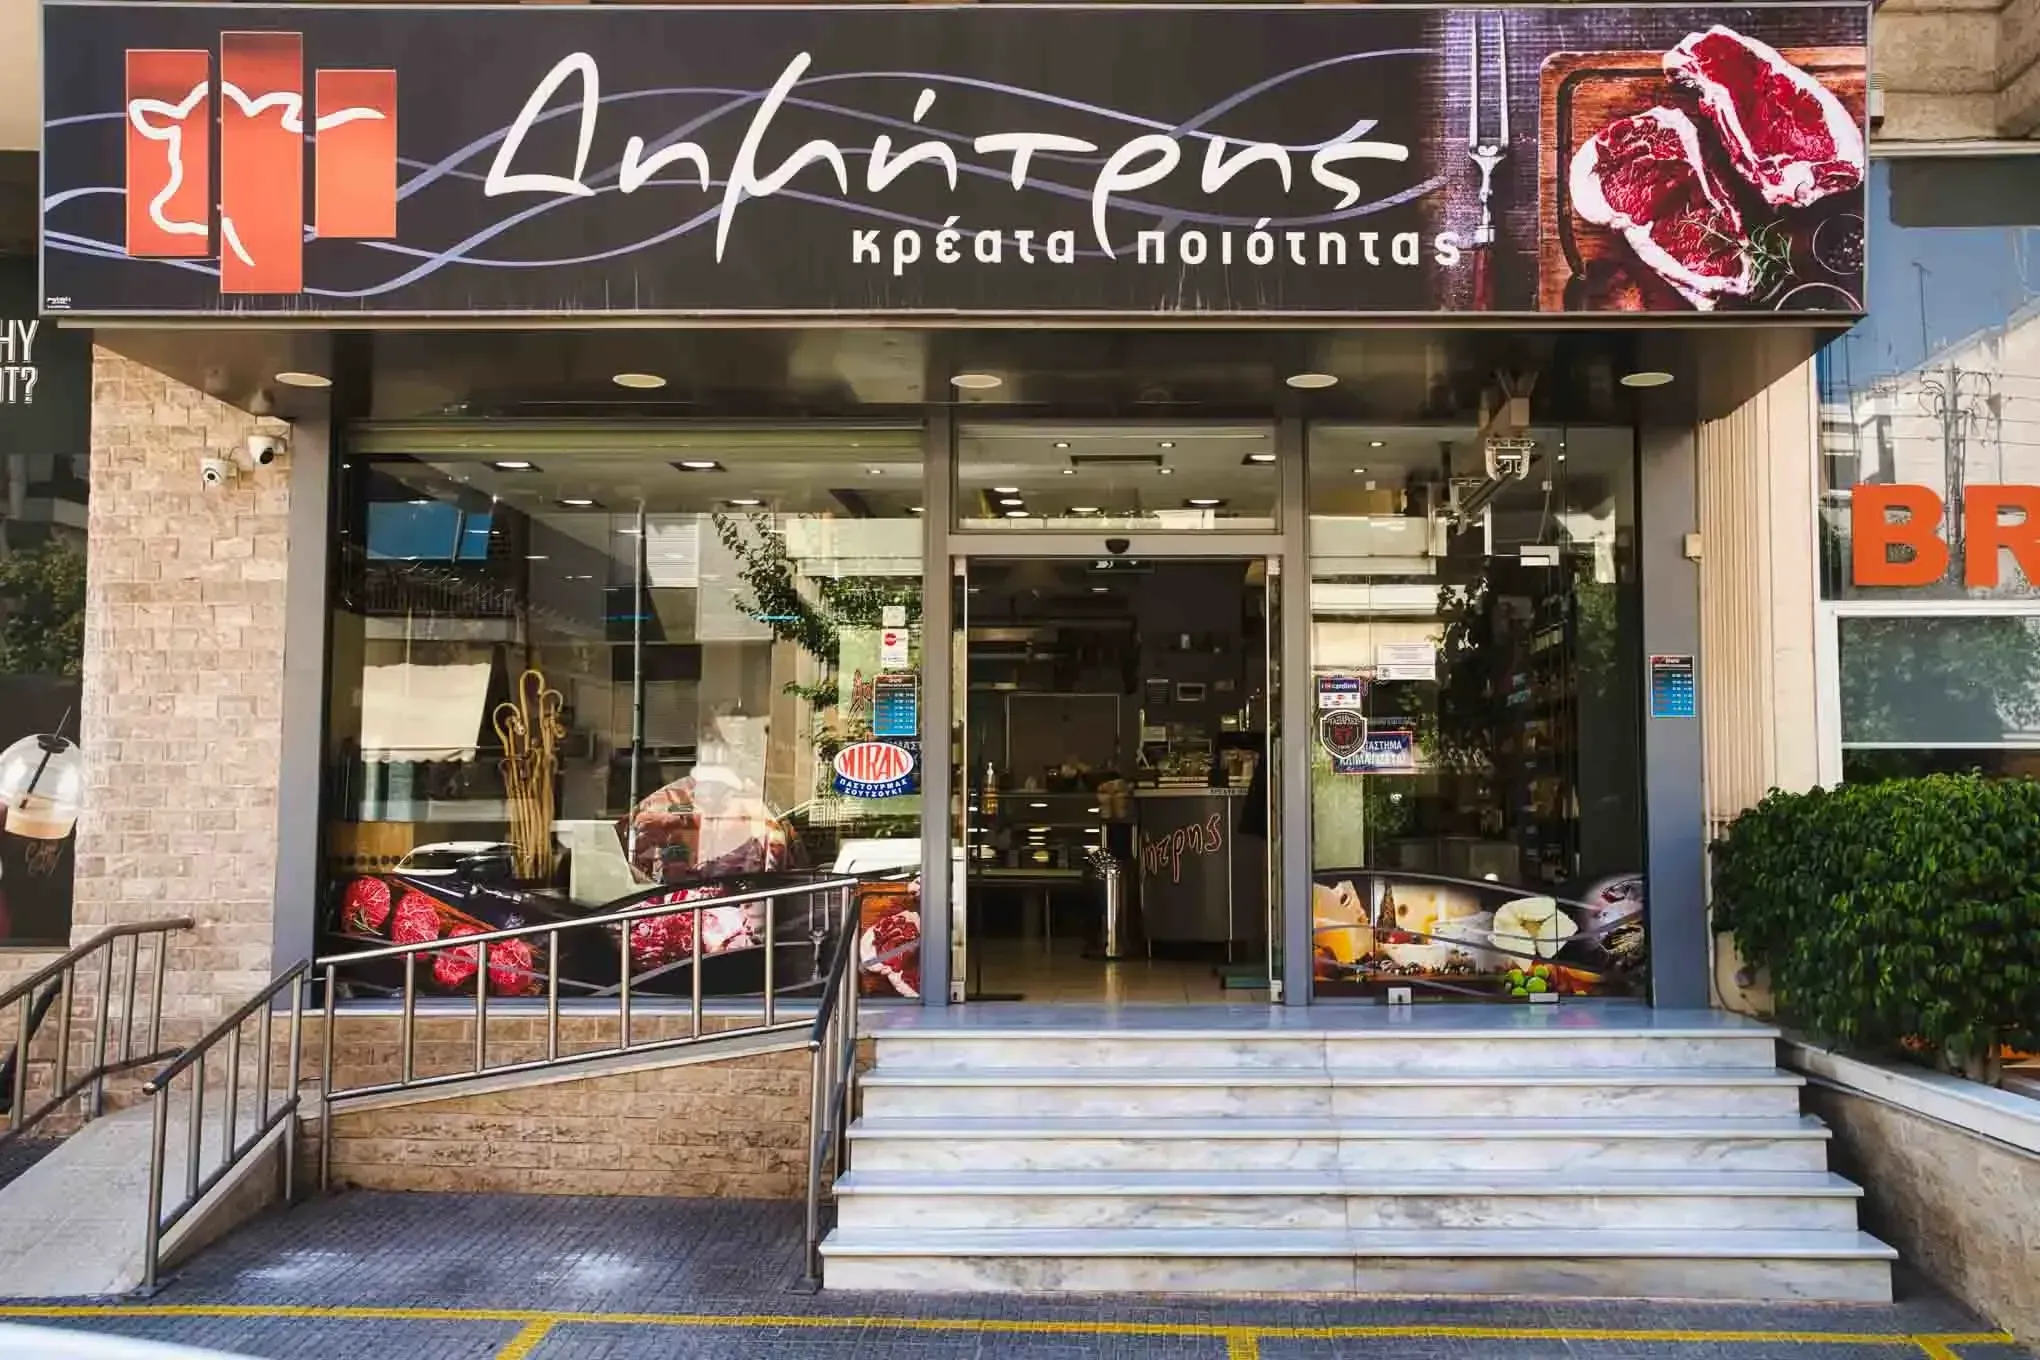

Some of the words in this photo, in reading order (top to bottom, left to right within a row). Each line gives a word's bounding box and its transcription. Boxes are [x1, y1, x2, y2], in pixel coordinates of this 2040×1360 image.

[484, 50, 1410, 264] Δημήτρης
[852, 215, 1076, 276] κρέατα
[1137, 217, 1462, 266] ποιότητας
[1852, 483, 2040, 589] BR
[838, 744, 907, 781] MIRAN
